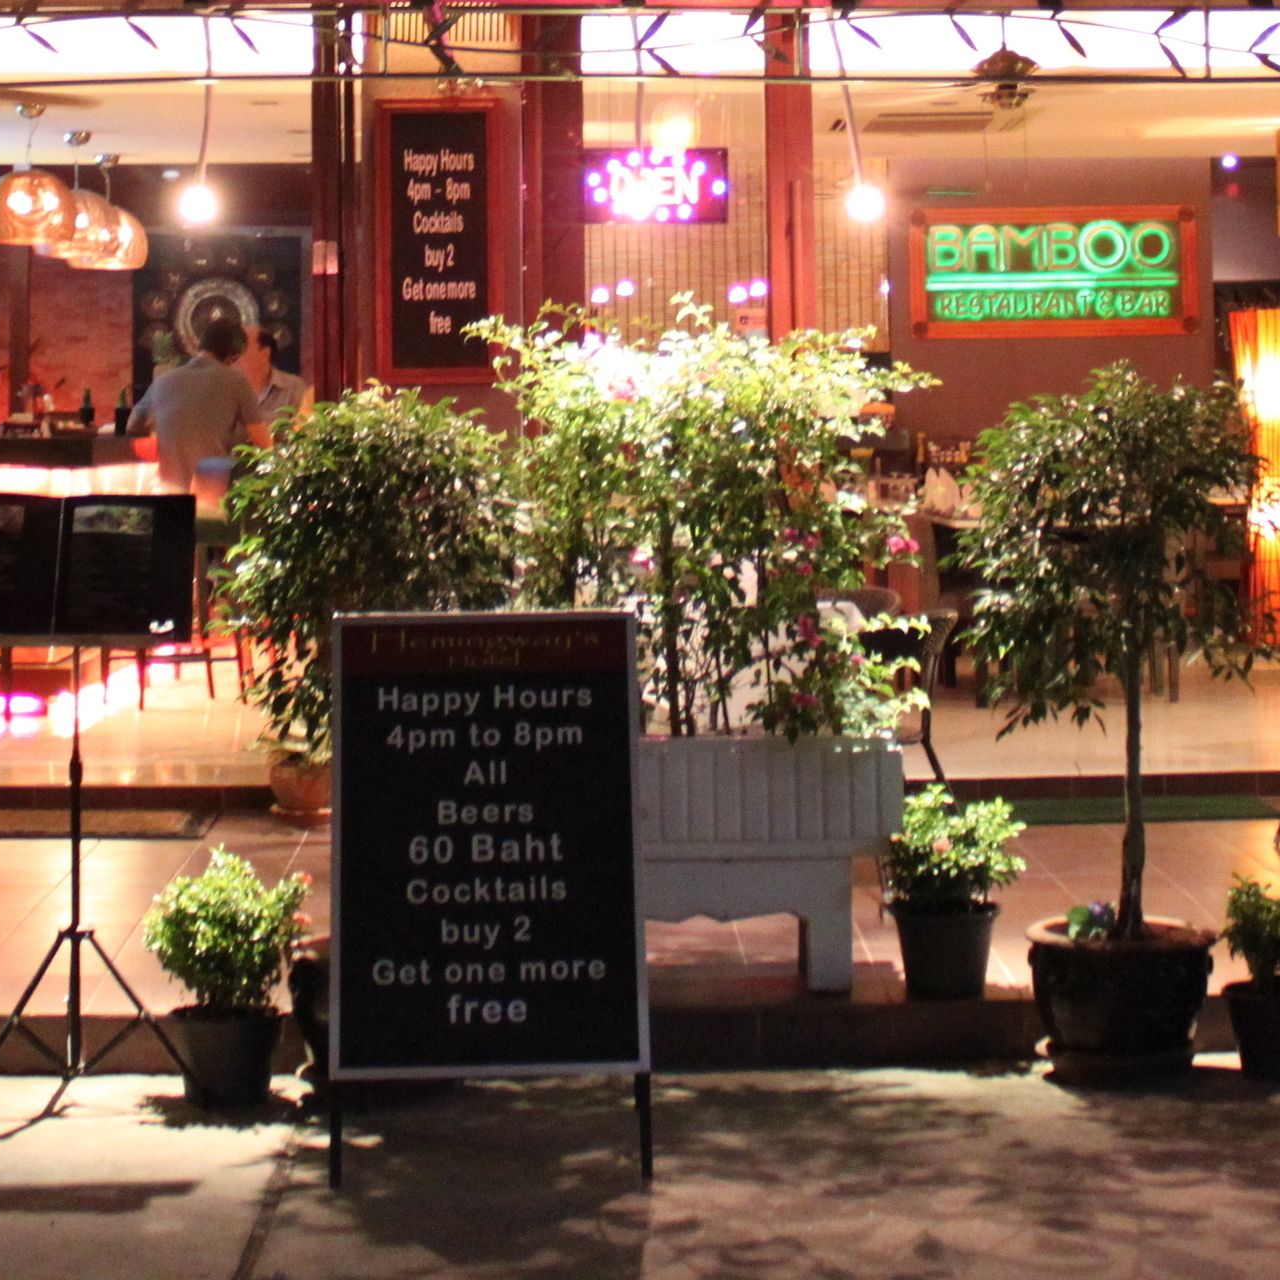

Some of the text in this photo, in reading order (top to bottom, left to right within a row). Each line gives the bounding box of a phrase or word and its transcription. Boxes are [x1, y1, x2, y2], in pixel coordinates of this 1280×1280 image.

[403, 148, 474, 177] Happy Hours
[406, 177, 432, 205] 4pm
[445, 177, 470, 205] 8pm
[412, 210, 464, 234] Cocktails
[424, 243, 455, 271] buy 2
[927, 220, 1176, 273] BAMBOO
[402, 277, 476, 301] Get one more
[936, 291, 1093, 319] RESTAURANT
[1117, 290, 1170, 317] BAR
[429, 311, 452, 334] free
[377, 684, 593, 716] Happy Hours
[386, 722, 583, 754] 4pm to 8pm
[463, 760, 508, 786] All
[437, 799, 534, 825] Beers
[408, 832, 564, 864] 60 Baht
[405, 875, 567, 905] Cocktails
[440, 915, 532, 950] buy 2
[372, 958, 607, 986] Get one more
[446, 993, 528, 1025] free
